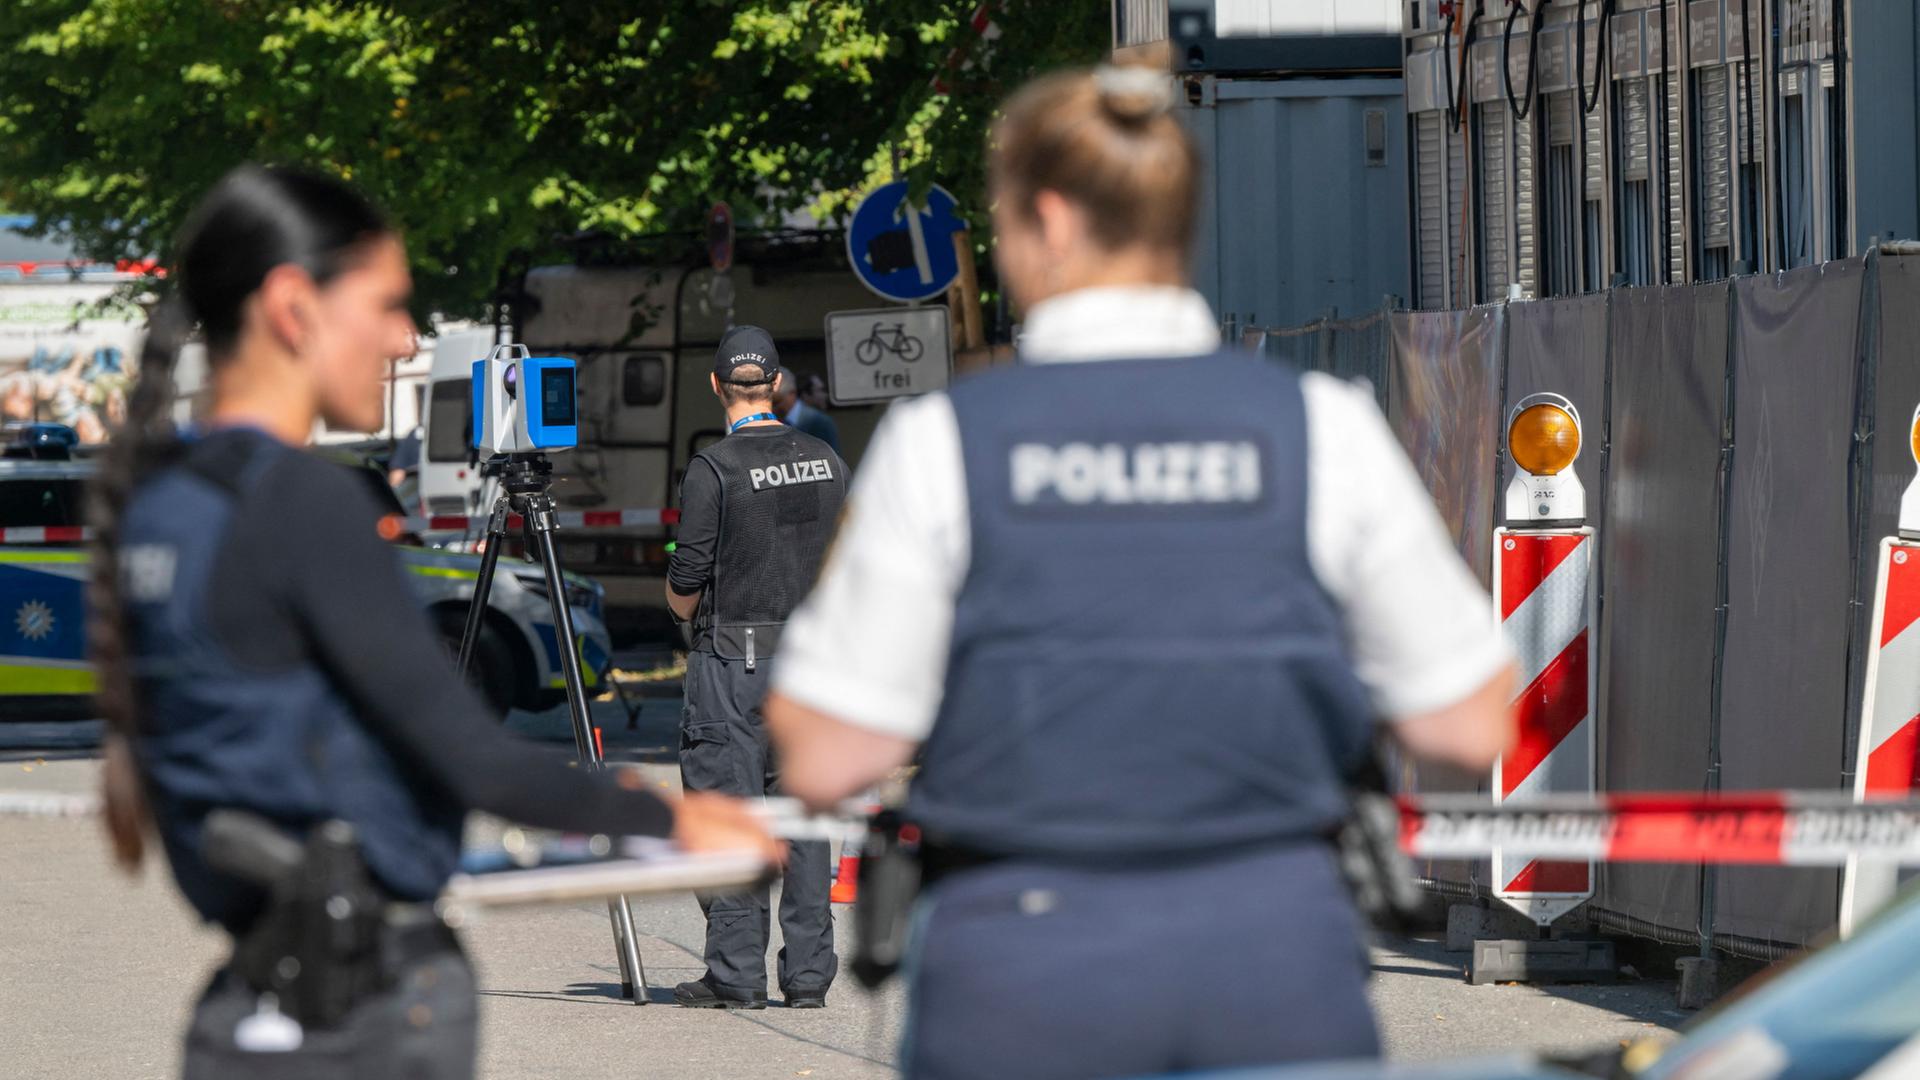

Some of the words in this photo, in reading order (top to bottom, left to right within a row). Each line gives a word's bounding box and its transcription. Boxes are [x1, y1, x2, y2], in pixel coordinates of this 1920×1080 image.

[730, 352, 767, 365] POLIZEI
[874, 368, 911, 389] frei
[749, 459, 833, 490] POLIZEI
[1009, 441, 1261, 504] POLIZEI
